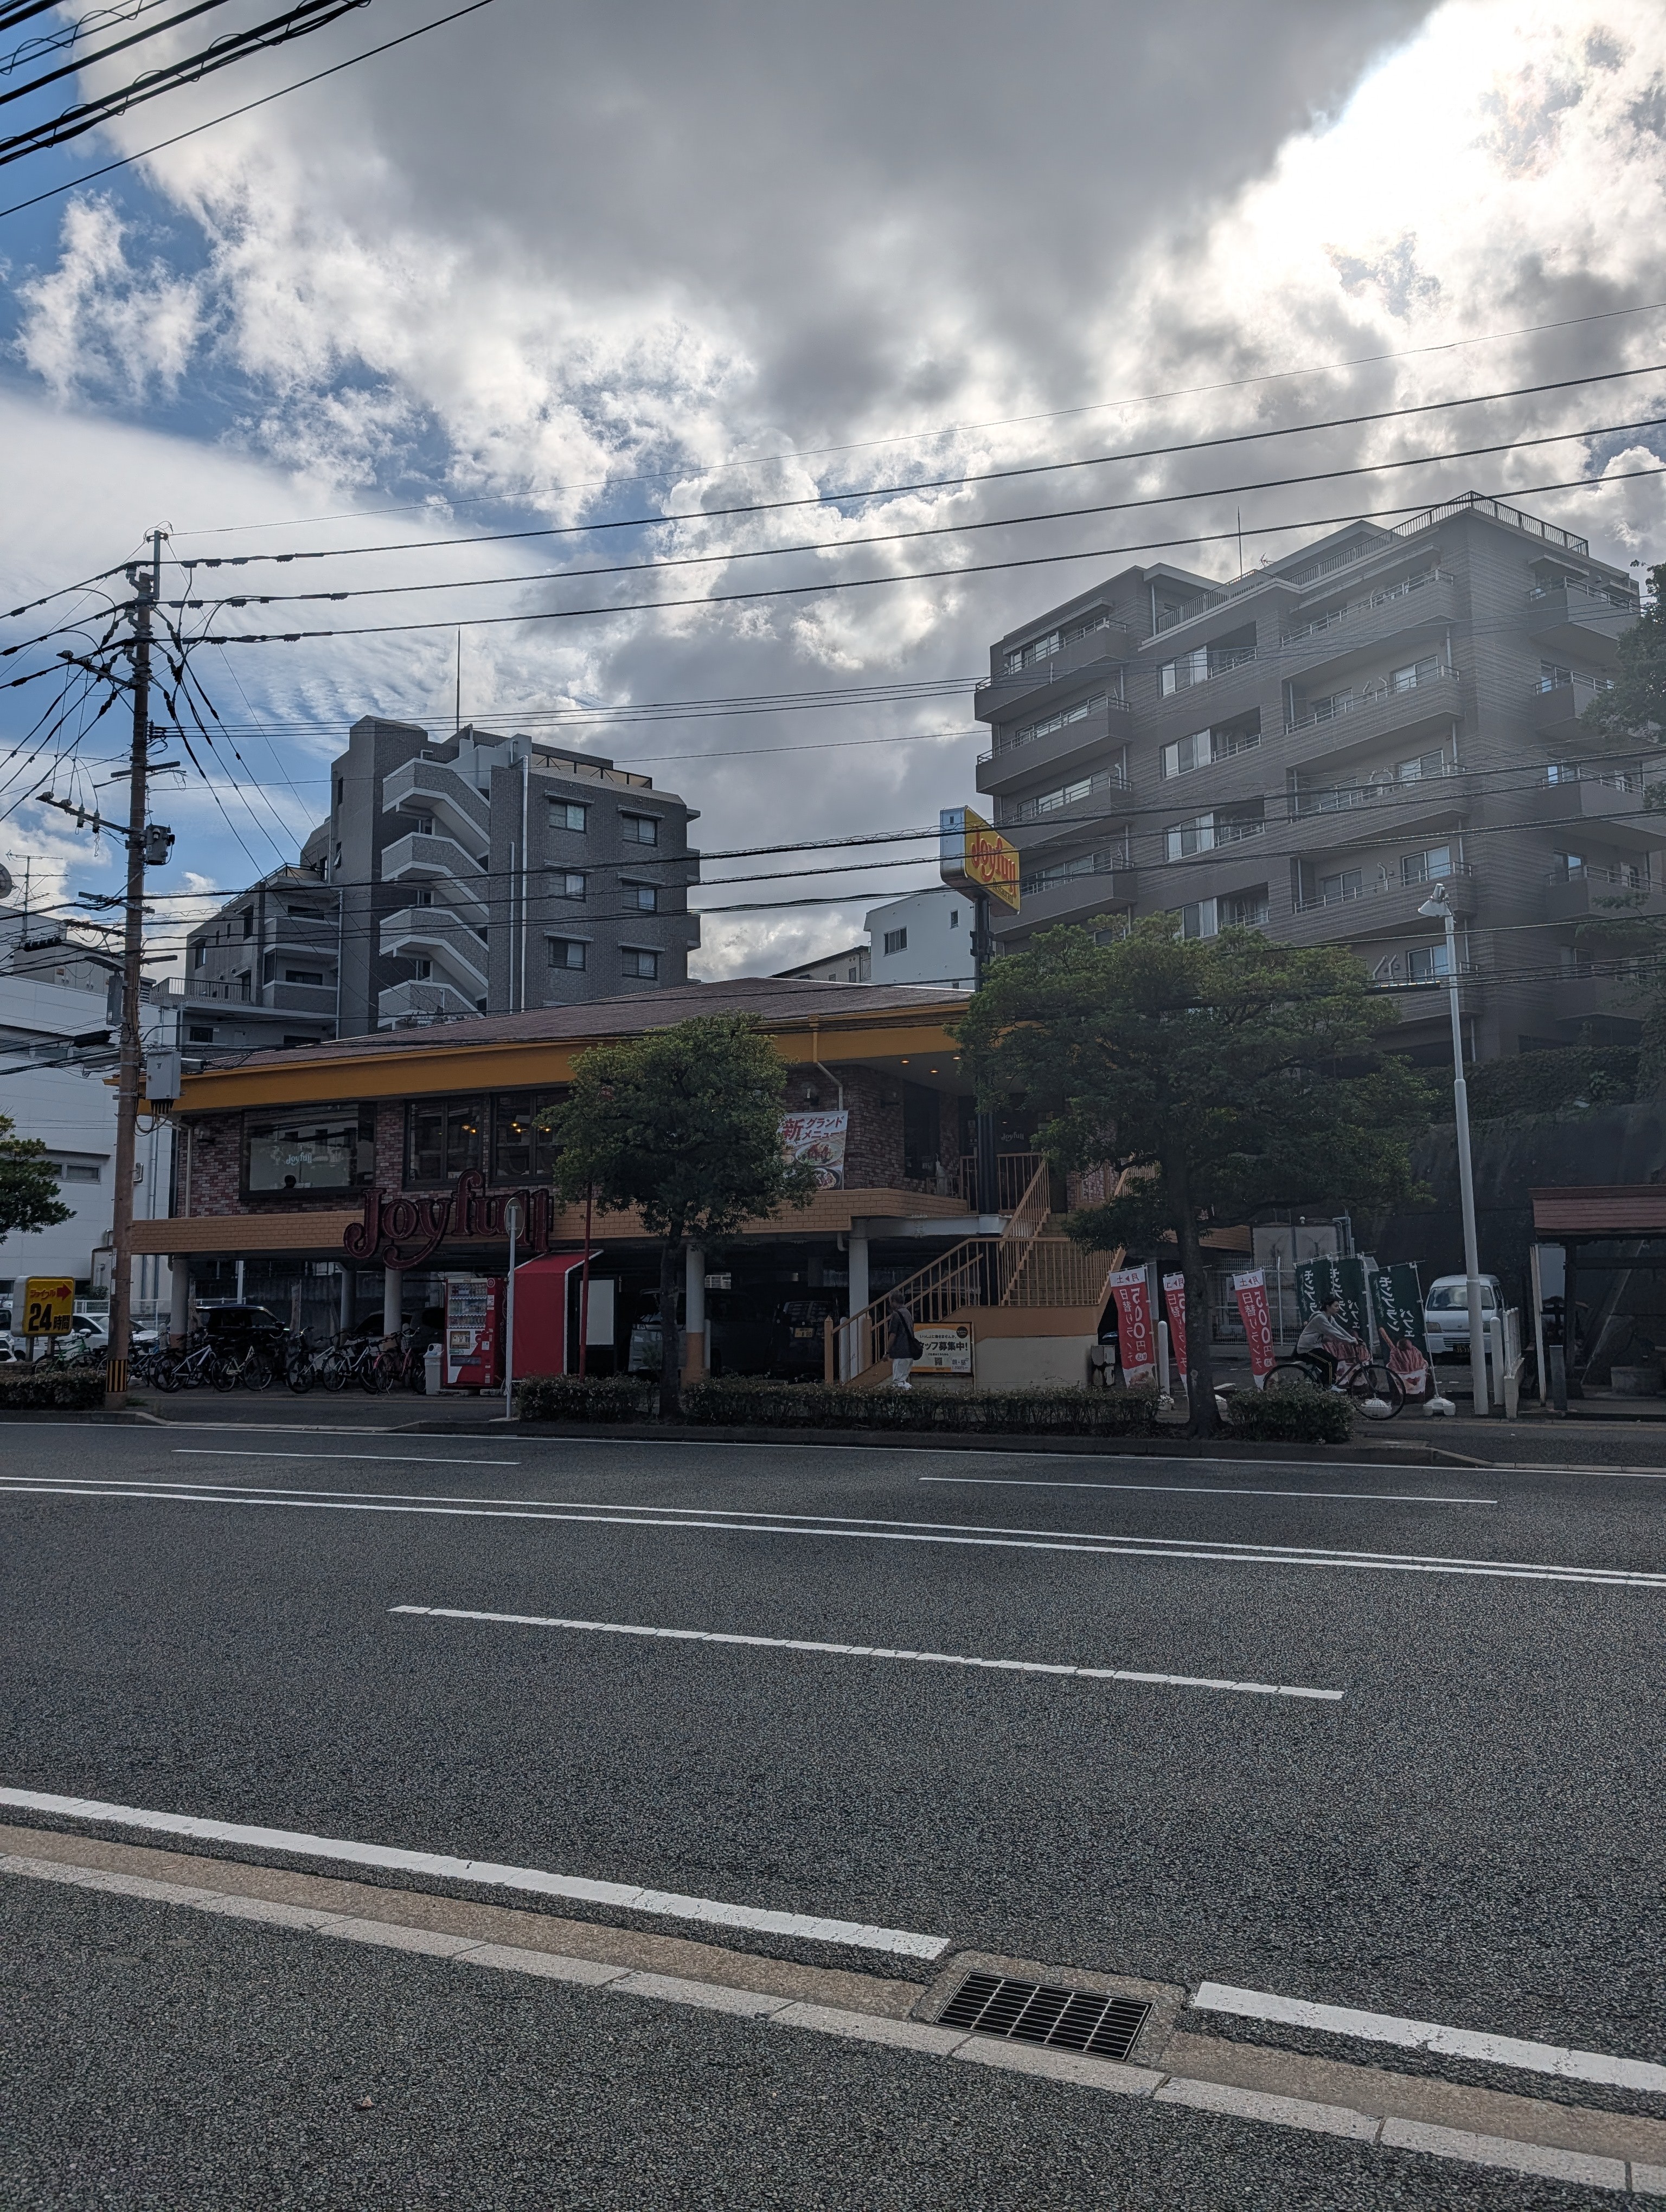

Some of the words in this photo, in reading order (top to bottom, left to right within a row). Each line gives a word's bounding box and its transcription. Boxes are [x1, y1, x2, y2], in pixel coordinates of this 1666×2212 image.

[971, 824, 1016, 898] Joyfull
[782, 1118, 805, 1140] 新
[805, 1116, 844, 1129] グランド
[802, 1130, 840, 1140] メニュー
[1001, 1131, 1024, 1142] Joyfull
[286, 1152, 312, 1166] Joyfull
[343, 1168, 551, 1270] Joyfull
[30, 1289, 56, 1300] ジョイフル
[28, 1303, 71, 1332] 24時間
[919, 1341, 968, 1351] タッフ募集中!
